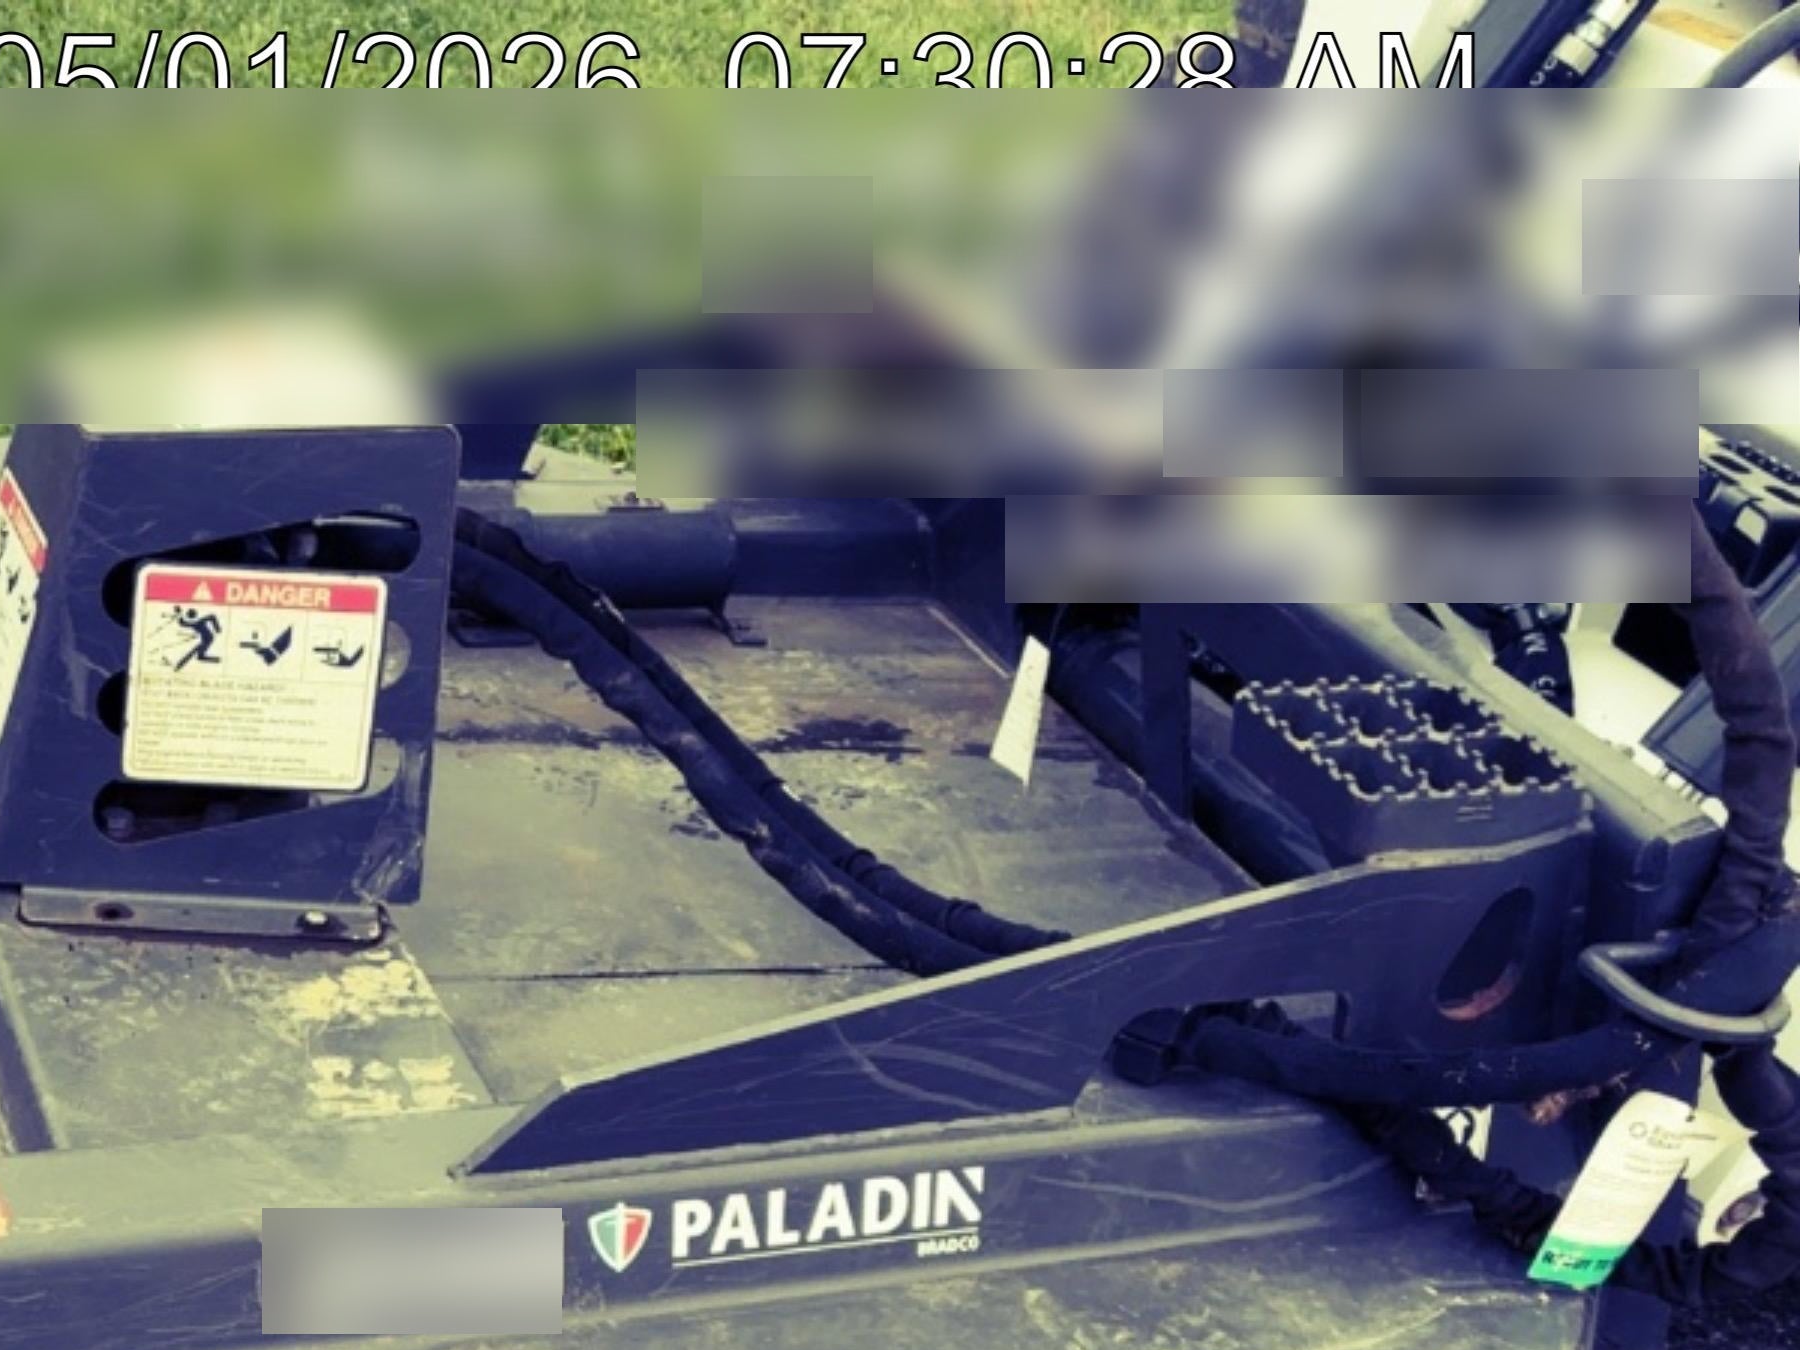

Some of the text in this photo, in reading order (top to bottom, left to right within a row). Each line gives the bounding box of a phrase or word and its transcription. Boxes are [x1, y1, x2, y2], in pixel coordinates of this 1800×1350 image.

[226, 580, 332, 608] DANGER
[671, 1166, 985, 1259] PALADIN
[916, 1234, 981, 1258] BRADCO
